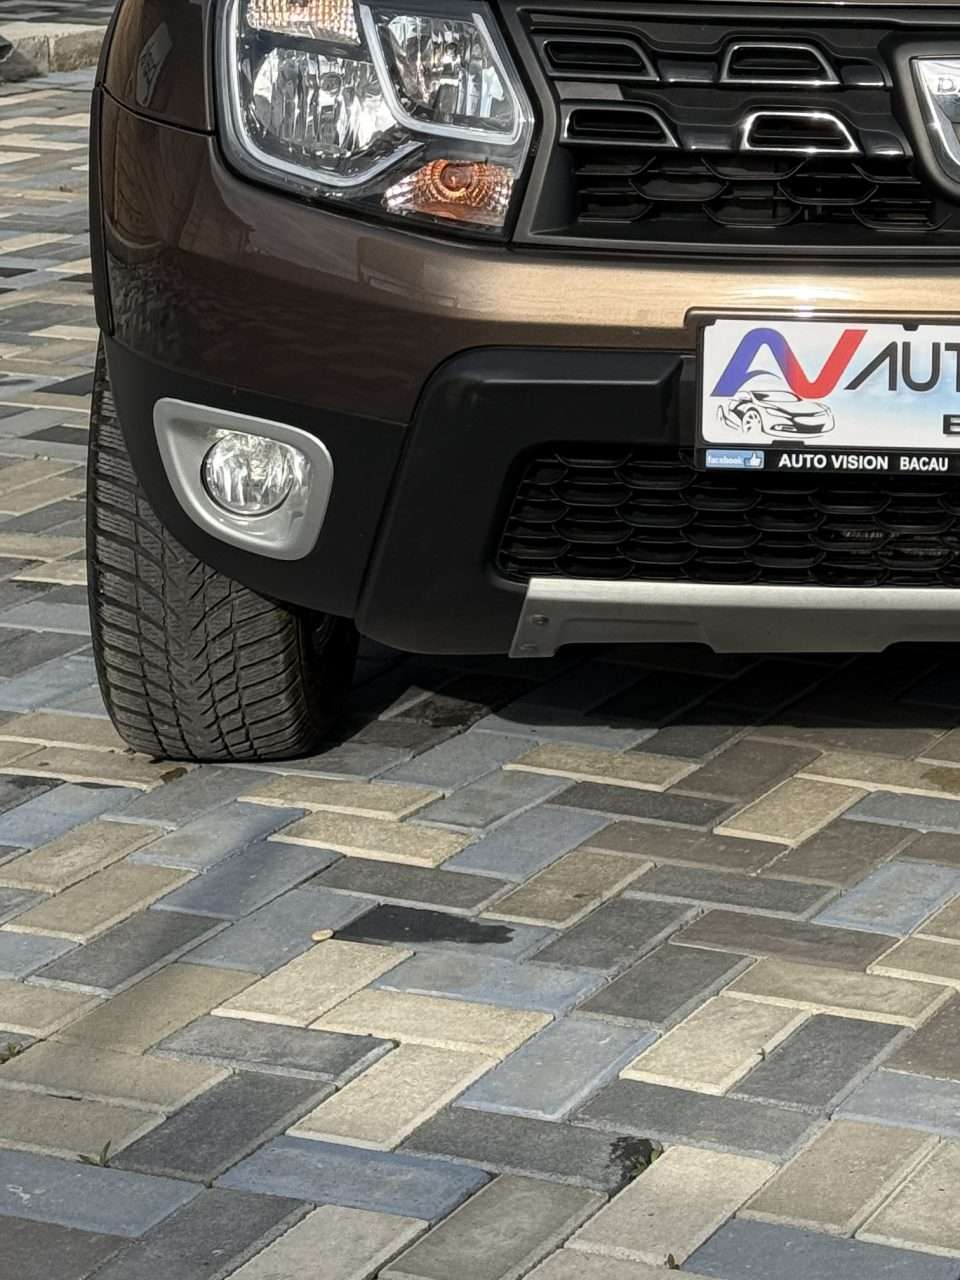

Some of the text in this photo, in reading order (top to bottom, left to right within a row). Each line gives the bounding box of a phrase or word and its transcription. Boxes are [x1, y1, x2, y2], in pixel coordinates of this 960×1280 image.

[778, 454, 827, 469] AUTO
[831, 455, 889, 470] VISION
[900, 457, 949, 471] BACAU
